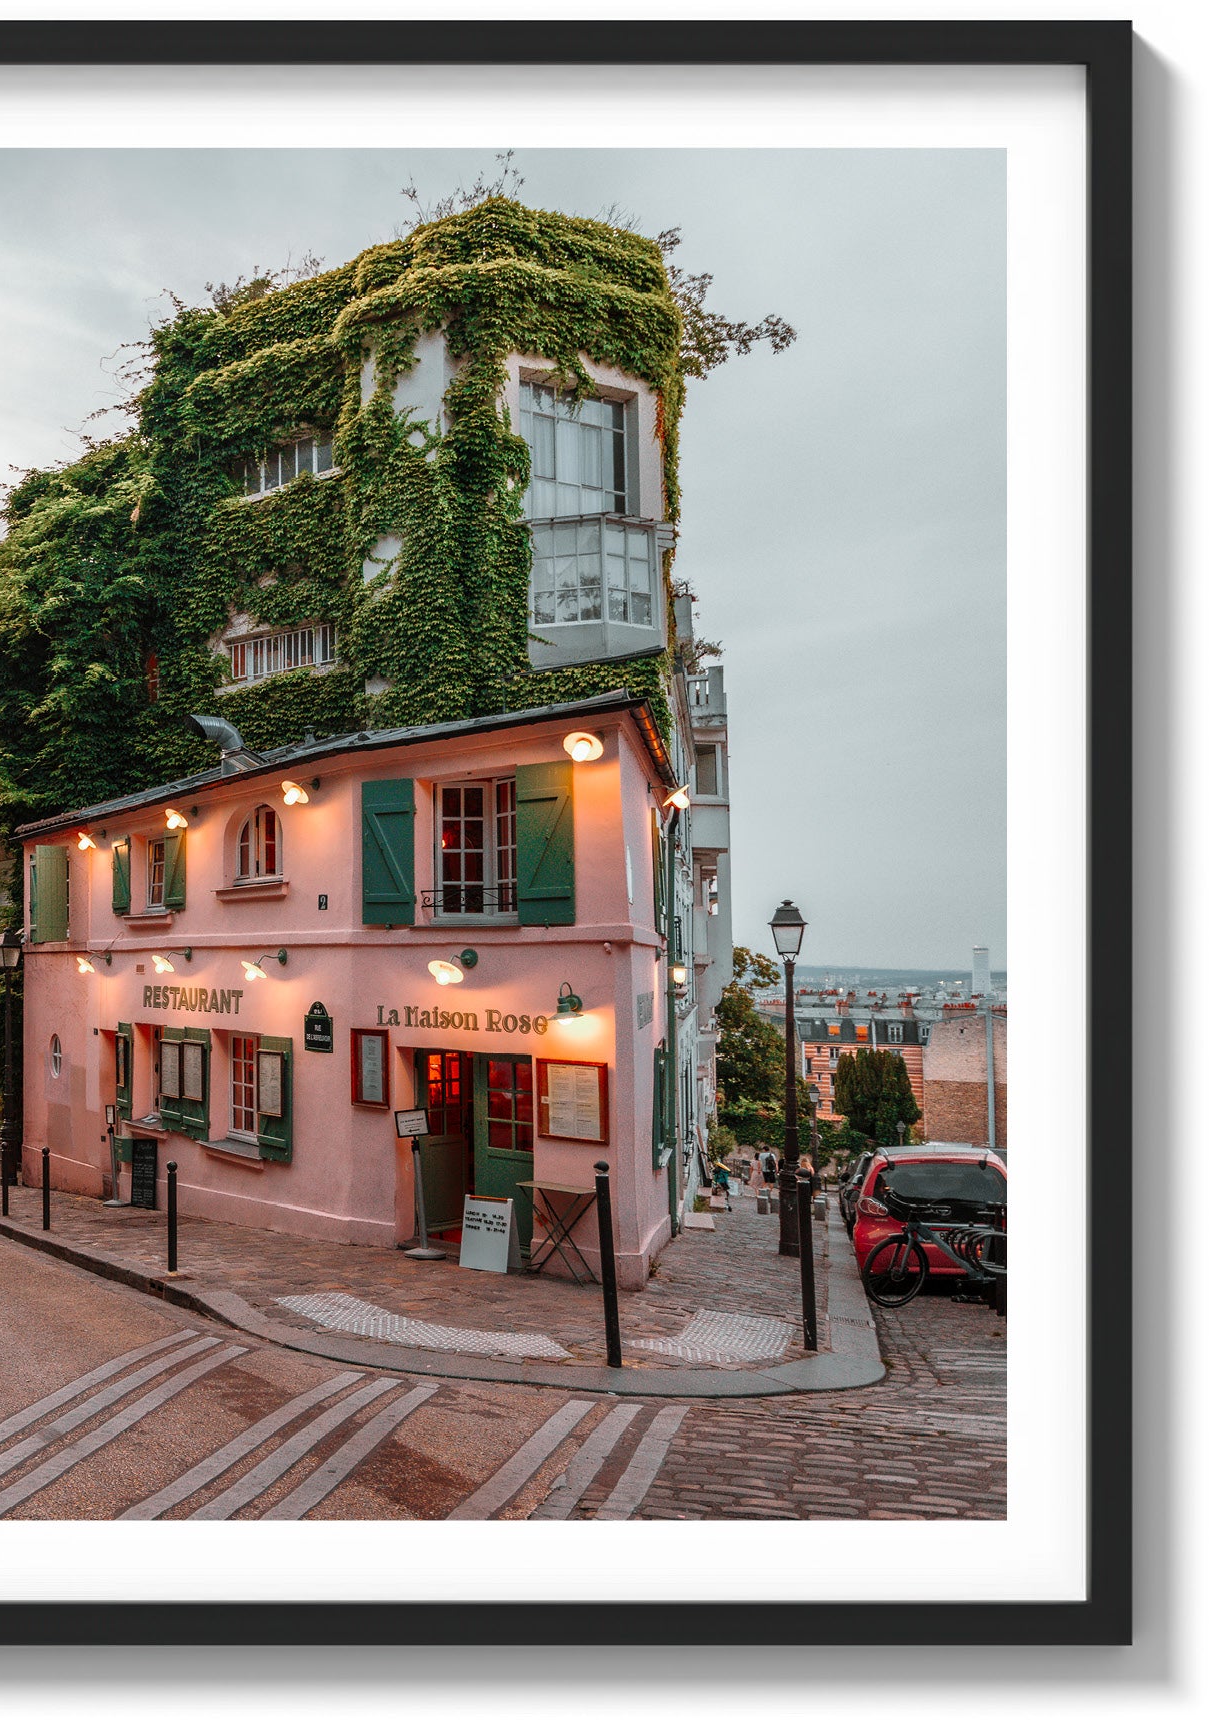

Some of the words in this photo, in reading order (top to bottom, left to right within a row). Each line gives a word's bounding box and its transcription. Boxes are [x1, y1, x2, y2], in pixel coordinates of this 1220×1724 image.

[143, 985, 244, 1014] RESTAURANT
[377, 1005, 400, 1027] La
[404, 1006, 479, 1031] Maison
[485, 1009, 548, 1035] Rose
